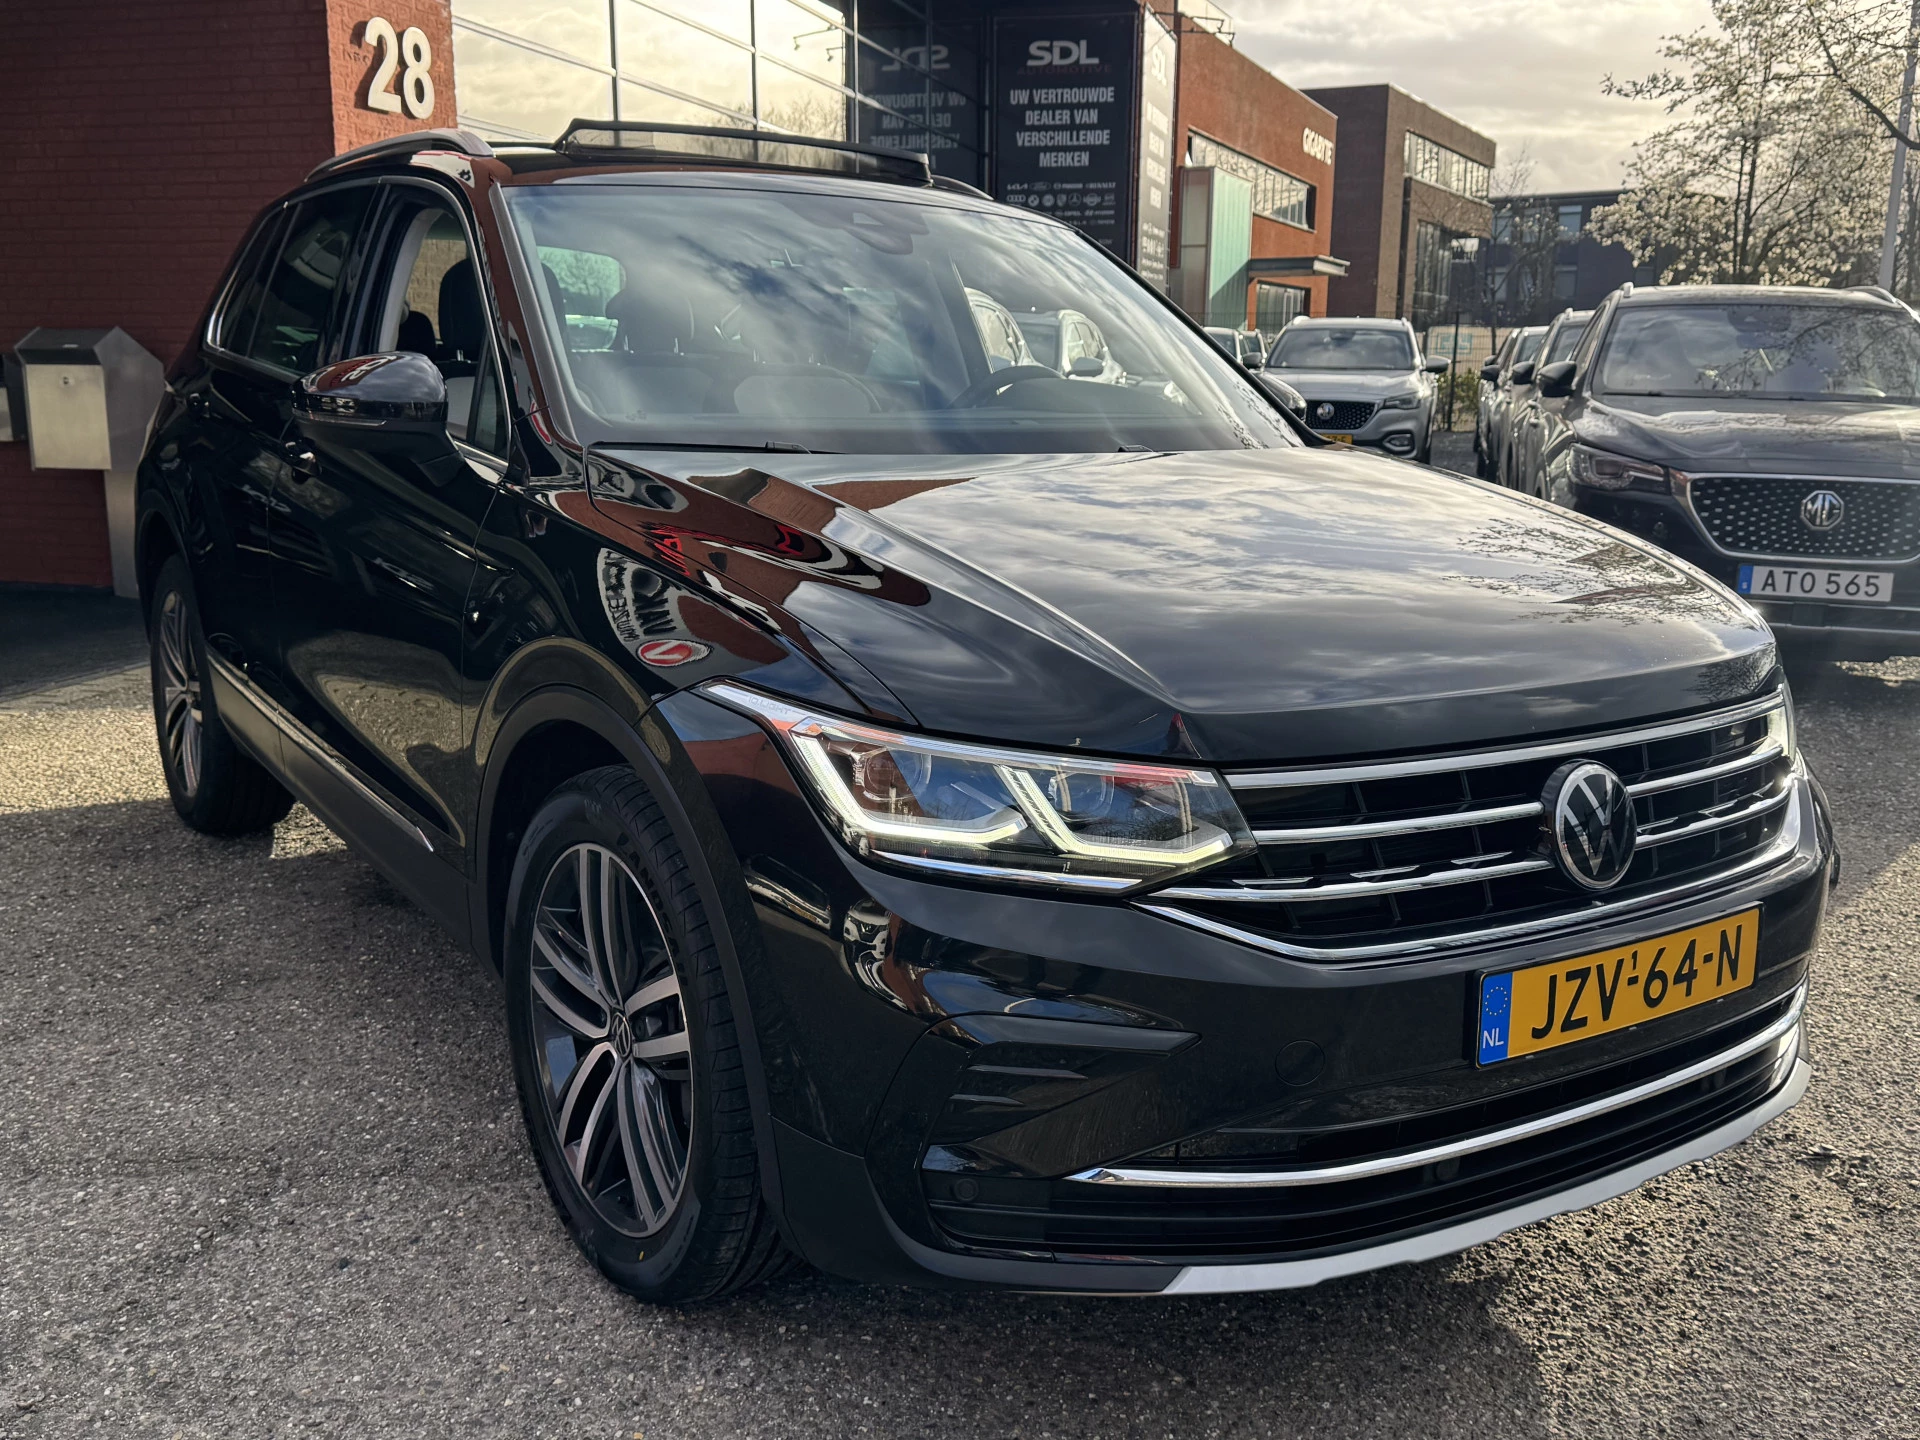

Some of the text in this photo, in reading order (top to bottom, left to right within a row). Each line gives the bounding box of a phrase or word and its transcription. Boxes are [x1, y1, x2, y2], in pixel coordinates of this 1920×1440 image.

[1026, 39, 1100, 66] SDL
[364, 16, 436, 120] 28
[1010, 86, 1115, 105] UW VERTROUWDE
[1025, 108, 1099, 126] DEALER VAN
[1016, 129, 1110, 147] VERSCHILLENDE
[1039, 151, 1090, 168] MERKEN
[1761, 569, 1880, 597] ATO 565
[1482, 1026, 1505, 1049] NL
